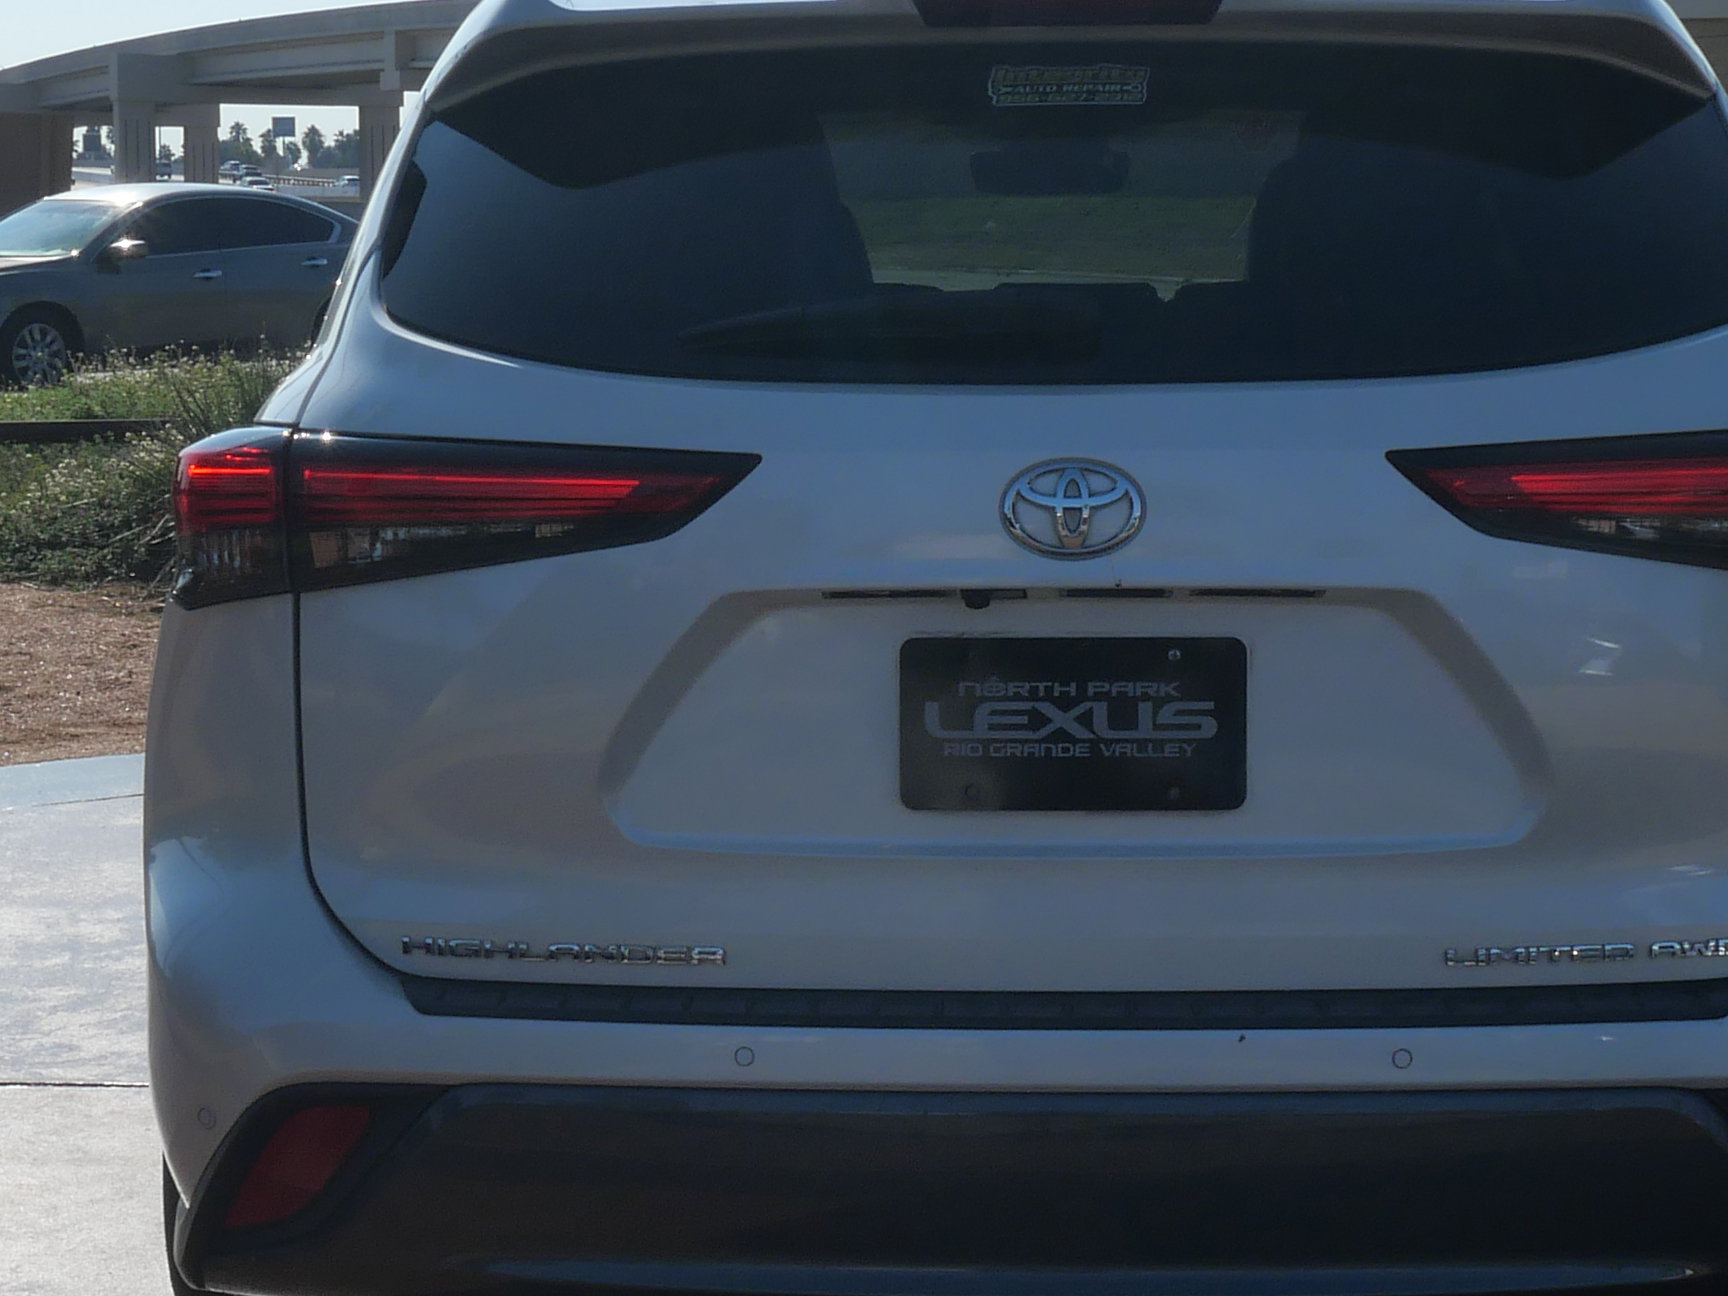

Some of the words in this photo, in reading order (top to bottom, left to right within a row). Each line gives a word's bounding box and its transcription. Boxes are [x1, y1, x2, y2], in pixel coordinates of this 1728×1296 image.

[1015, 84, 1056, 92] AUTO
[1063, 84, 1120, 92] REPAIR
[958, 680, 1076, 697] NORTH
[1087, 680, 1182, 697] PARK
[923, 701, 1219, 739] LEXUS
[944, 743, 982, 757] RIO
[989, 743, 1091, 757] GRANDE
[1100, 743, 1197, 757] VALLEY
[400, 935, 727, 966] HIGHLANDER
[1444, 943, 1635, 966] LIMITED
